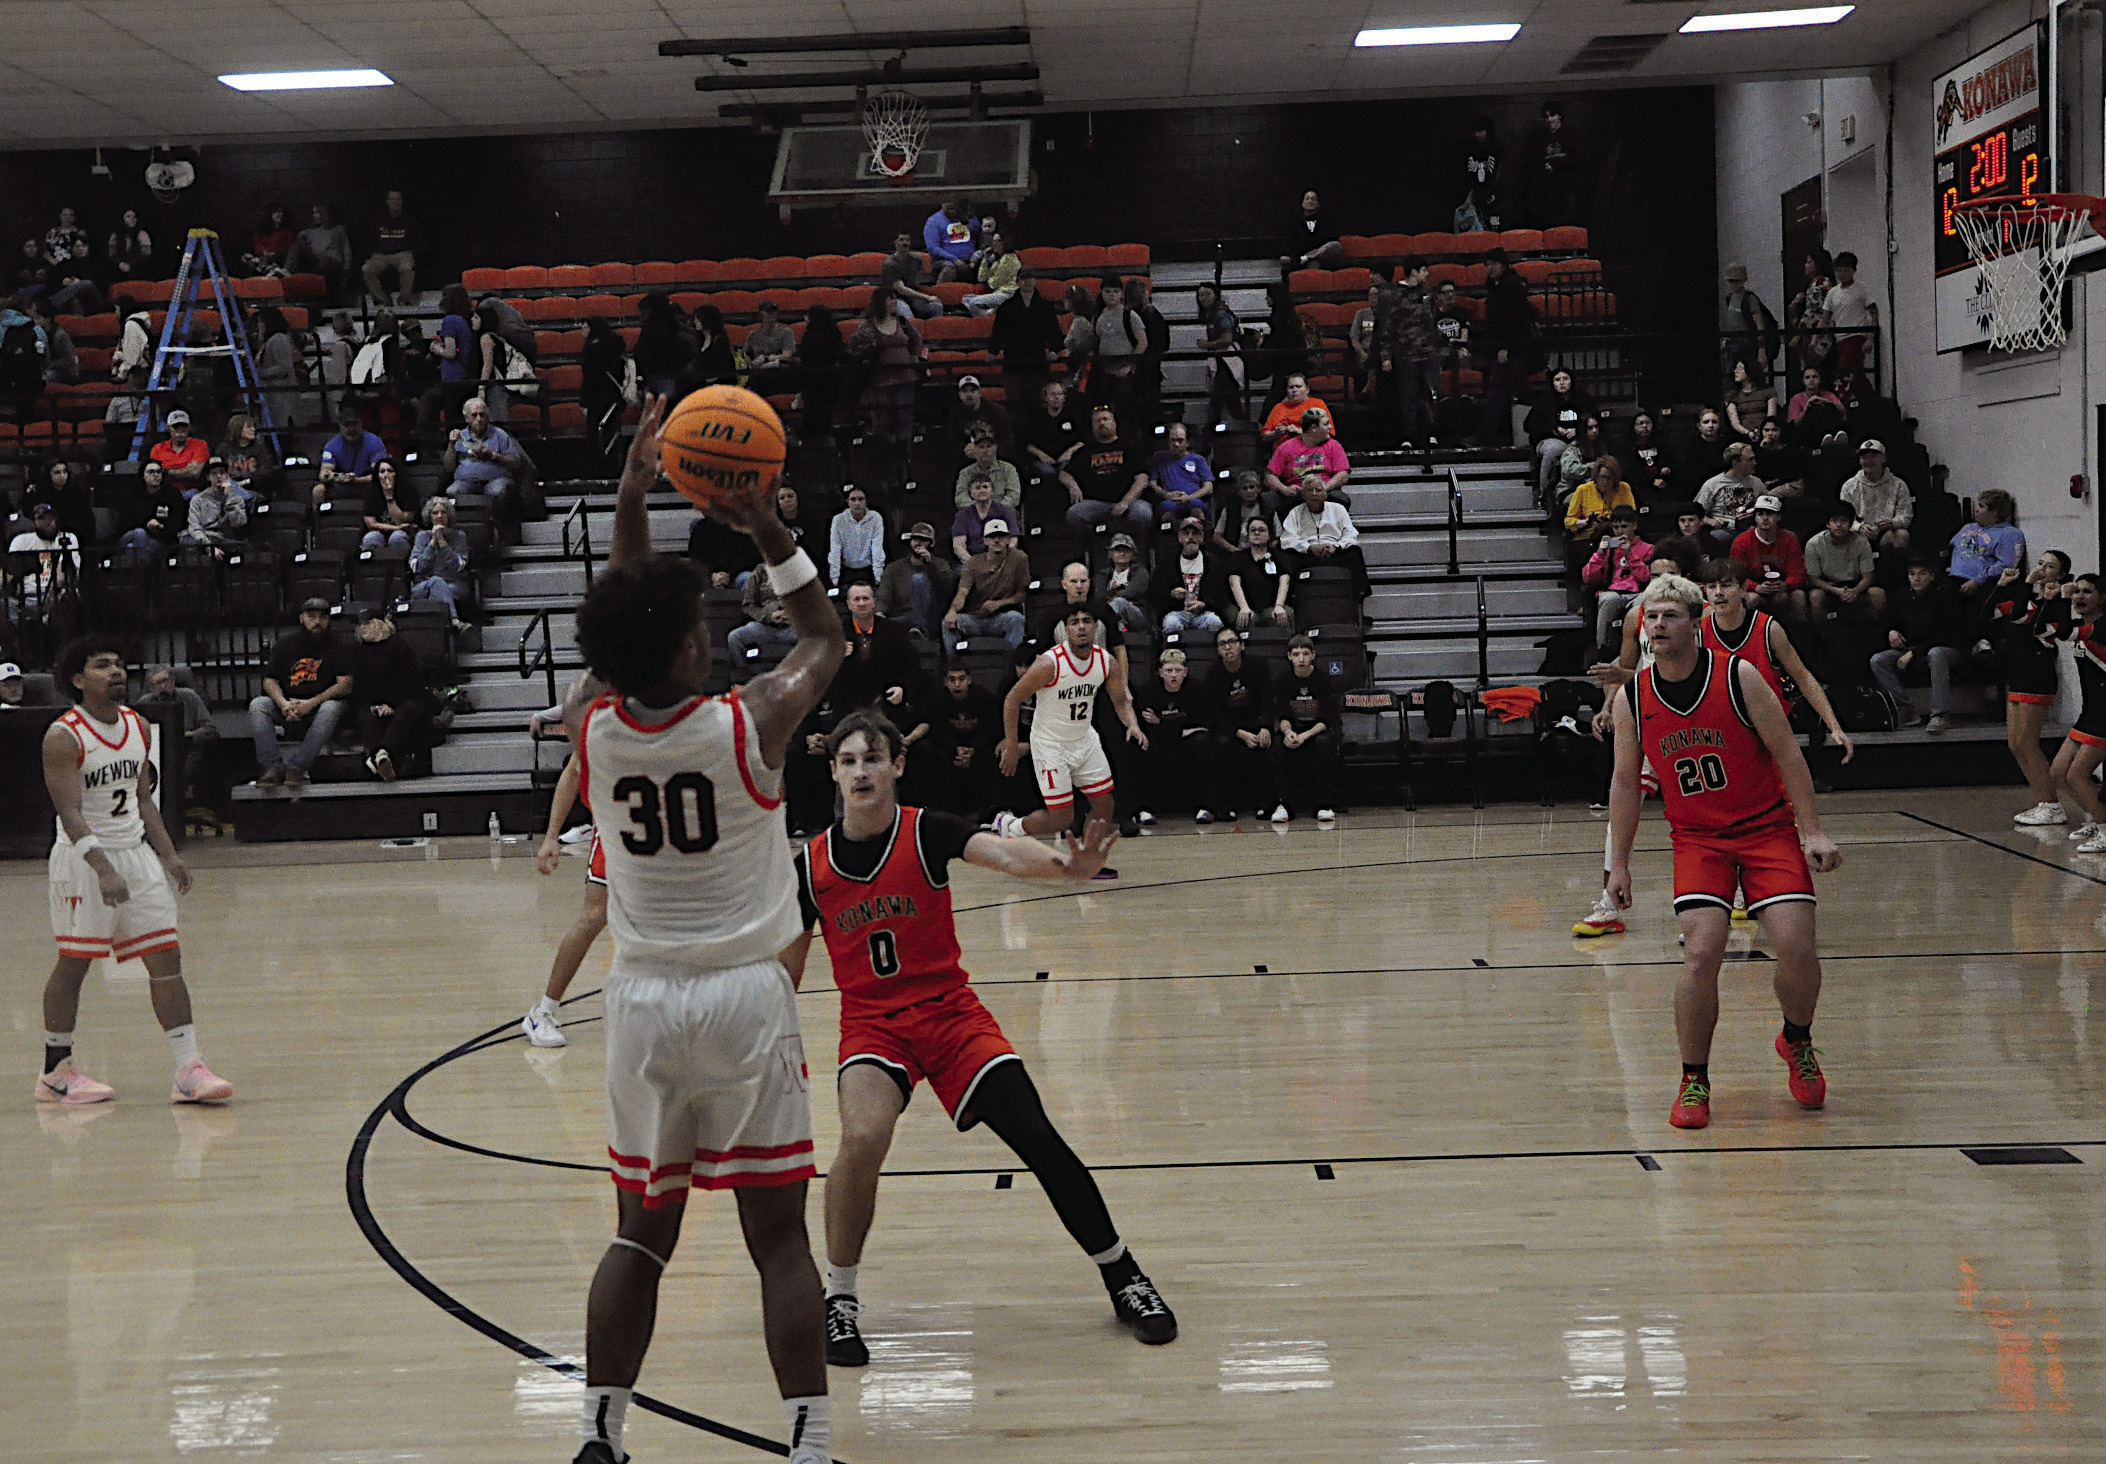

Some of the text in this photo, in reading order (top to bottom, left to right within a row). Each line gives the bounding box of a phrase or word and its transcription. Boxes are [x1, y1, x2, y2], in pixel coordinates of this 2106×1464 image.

[1961, 45, 2038, 124] KONAWA
[1970, 131, 2006, 193] 2:00
[1965, 295, 1980, 314] THE
[1058, 683, 1096, 700] WEWOK
[1069, 702, 1088, 721] 12
[1660, 727, 1728, 758] KONAWA
[84, 760, 139, 789] WEWOK
[1674, 753, 1728, 797] 20
[111, 789, 128, 816] 2
[613, 772, 719, 856] 30
[836, 894, 918, 934] KONAWA
[867, 928, 901, 979] 0
